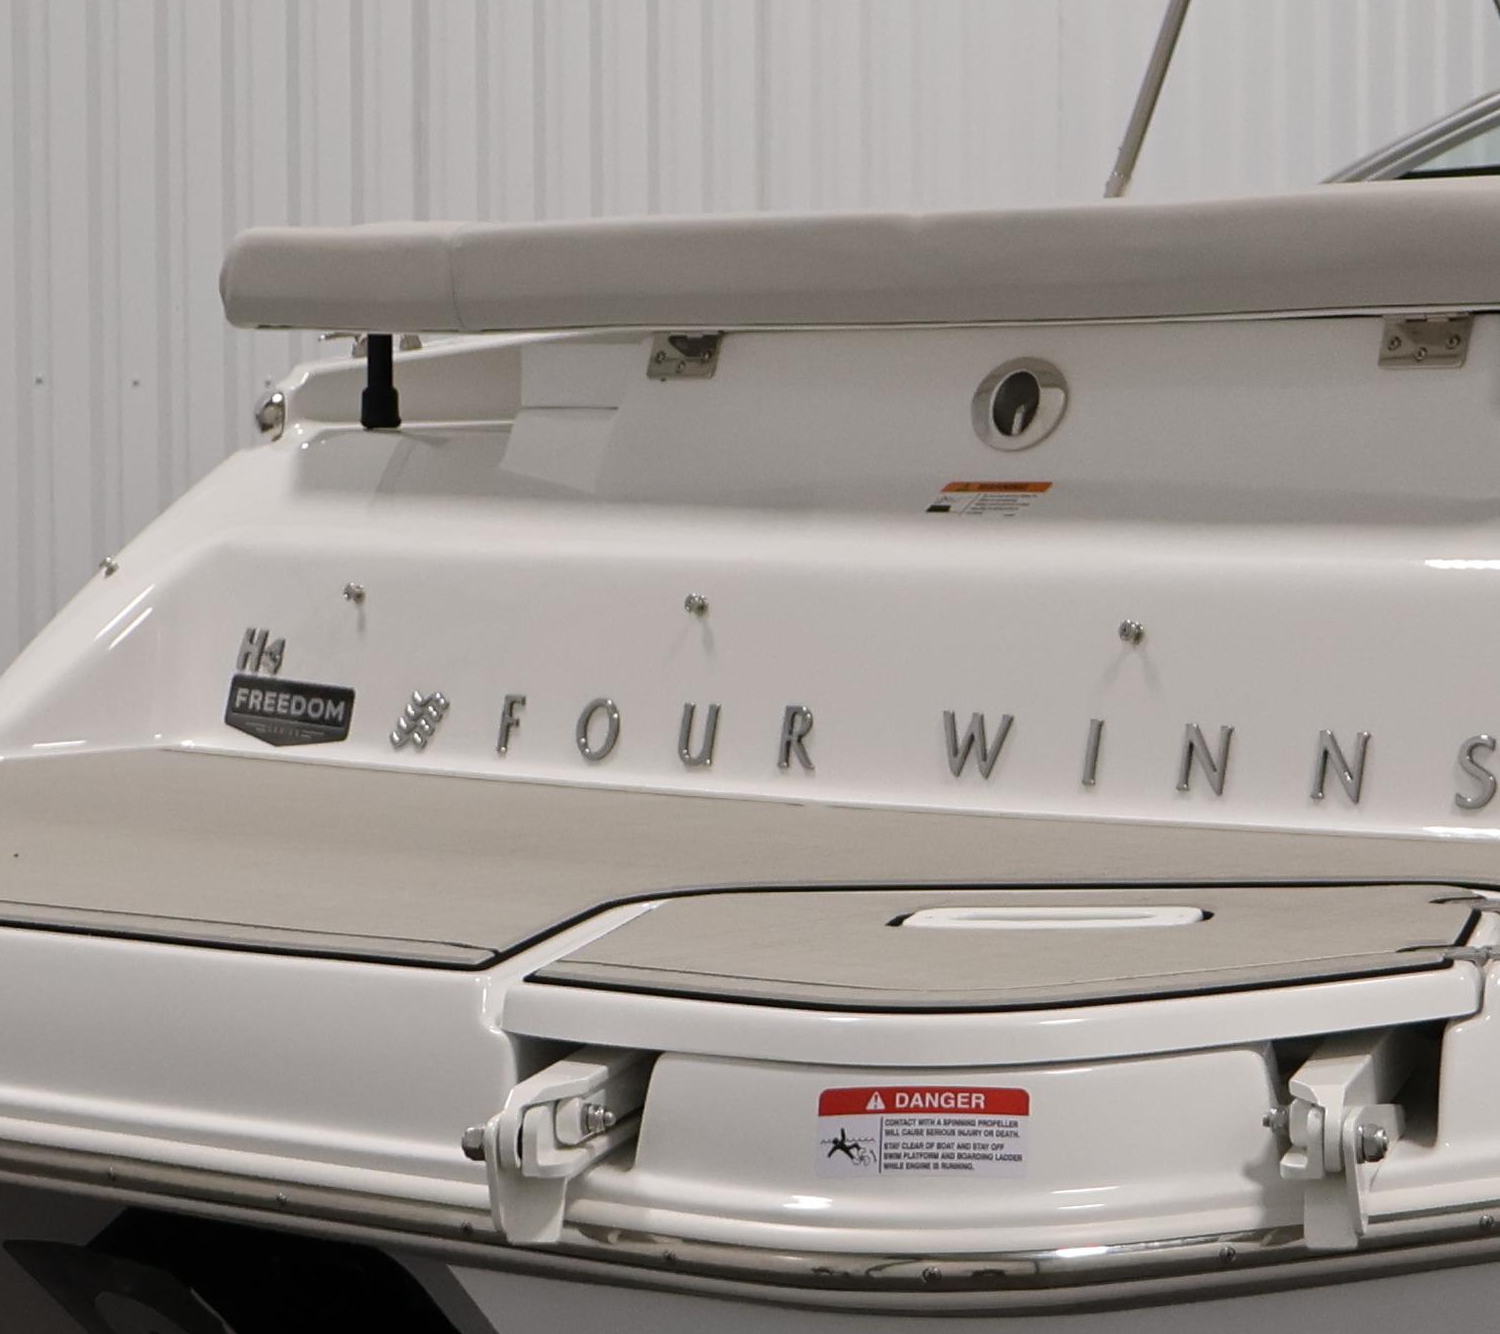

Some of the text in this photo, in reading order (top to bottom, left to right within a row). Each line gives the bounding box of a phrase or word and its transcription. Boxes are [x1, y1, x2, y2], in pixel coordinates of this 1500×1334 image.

[237, 627, 286, 675] H4
[235, 687, 346, 723] FREEDOM
[497, 695, 1498, 810] FOUR WINNS
[894, 1091, 986, 1110] DANGER
